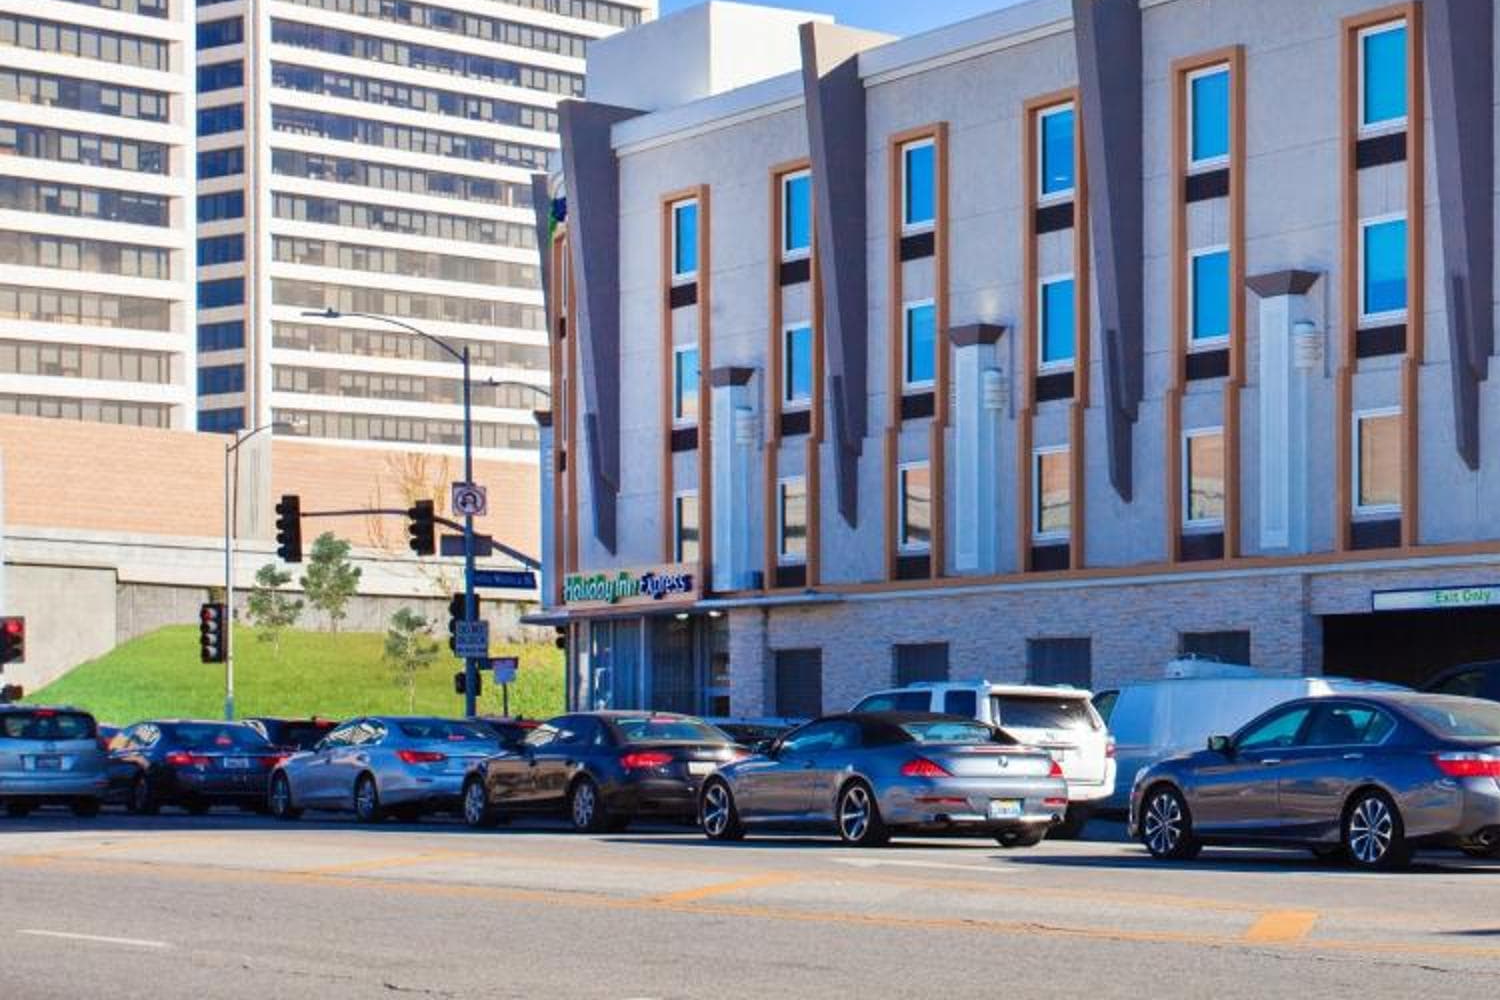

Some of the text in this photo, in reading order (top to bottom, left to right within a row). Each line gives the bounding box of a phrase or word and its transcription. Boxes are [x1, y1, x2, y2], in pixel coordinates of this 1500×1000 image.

[564, 574, 617, 604] Holiday
[616, 572, 640, 597] Inn
[640, 572, 692, 600] Express
[1435, 589, 1490, 604] Exit Only
